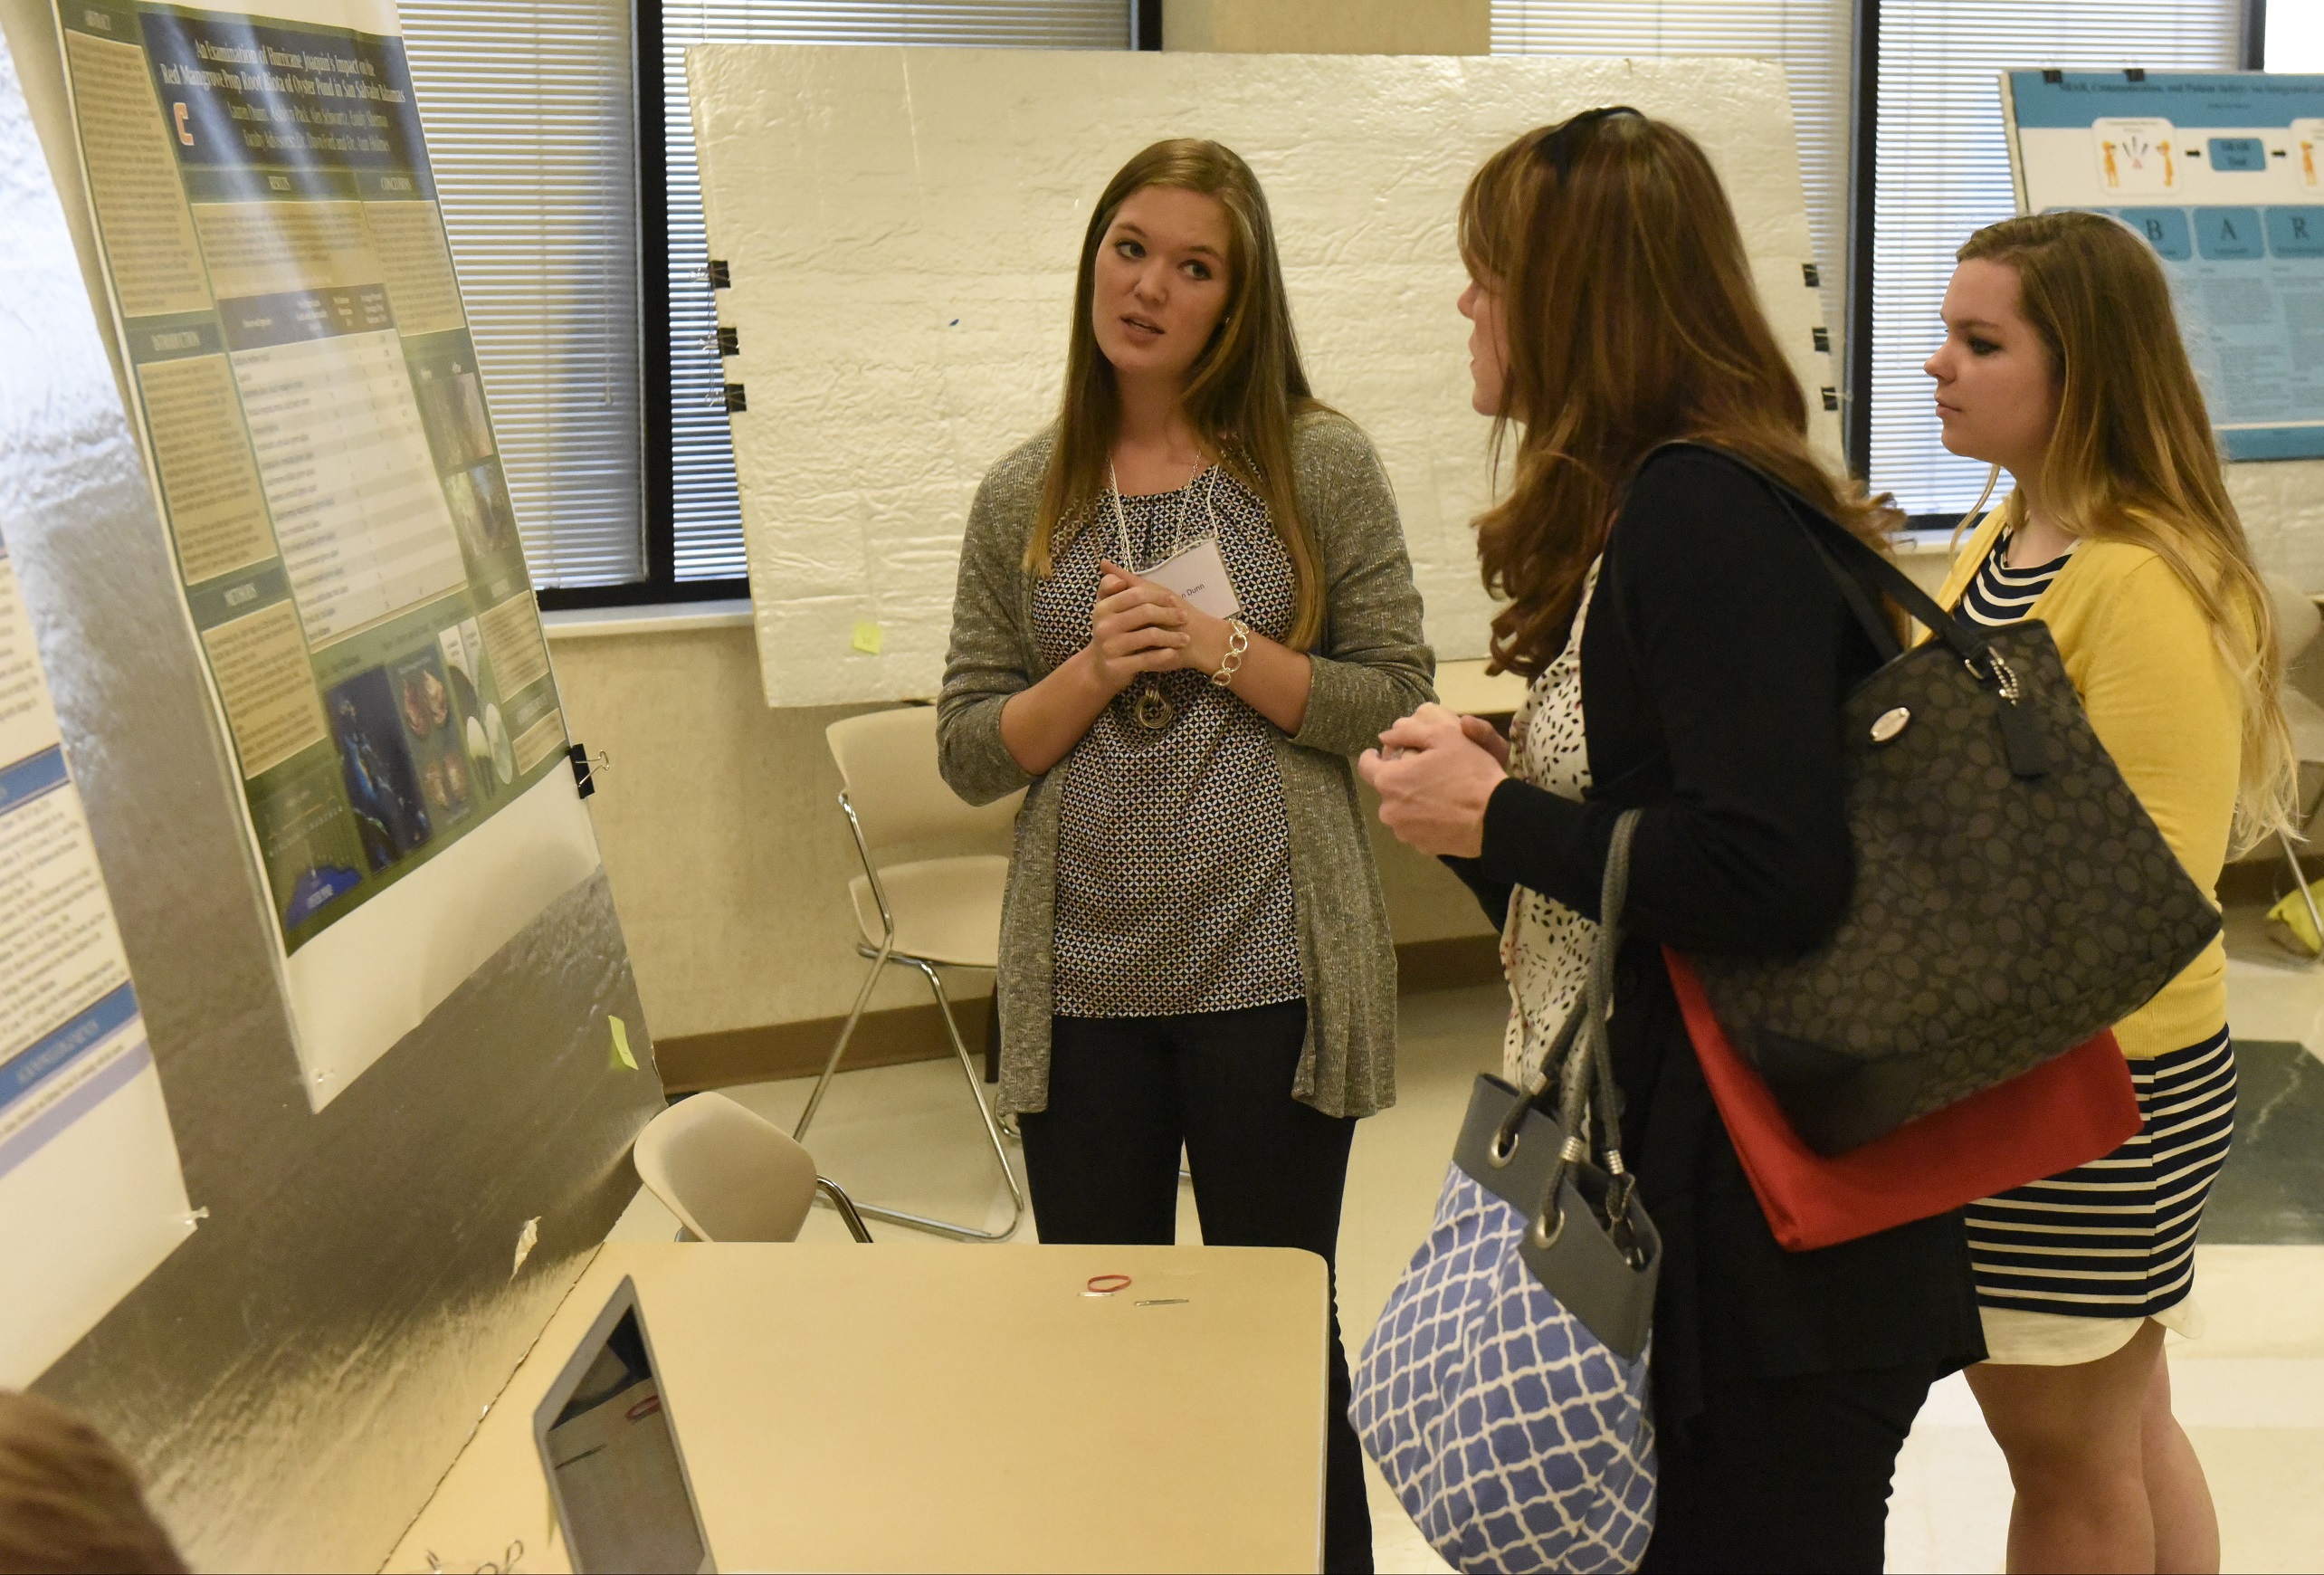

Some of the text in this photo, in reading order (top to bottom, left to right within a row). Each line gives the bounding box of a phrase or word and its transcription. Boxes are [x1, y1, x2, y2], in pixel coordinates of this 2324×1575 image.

[205, 40, 258, 63] Examination
[259, 44, 269, 64] of
[266, 46, 303, 69] Hurricane
[302, 51, 336, 74] Joaquin's
[334, 54, 360, 77] Impact
[160, 63, 181, 84] Red
[179, 64, 226, 91] Mangrove
[221, 69, 242, 94] Prop
[240, 71, 262, 91] Root
[284, 73, 294, 92] of
[292, 74, 316, 98] Oyster
[315, 77, 335, 96] Pond
[333, 77, 343, 97] in
[341, 79, 357, 98] San
[2146, 219, 2163, 241] B
[2221, 218, 2237, 240] A
[2292, 216, 2309, 239] R
[1186, 584, 1205, 596] Dunn
